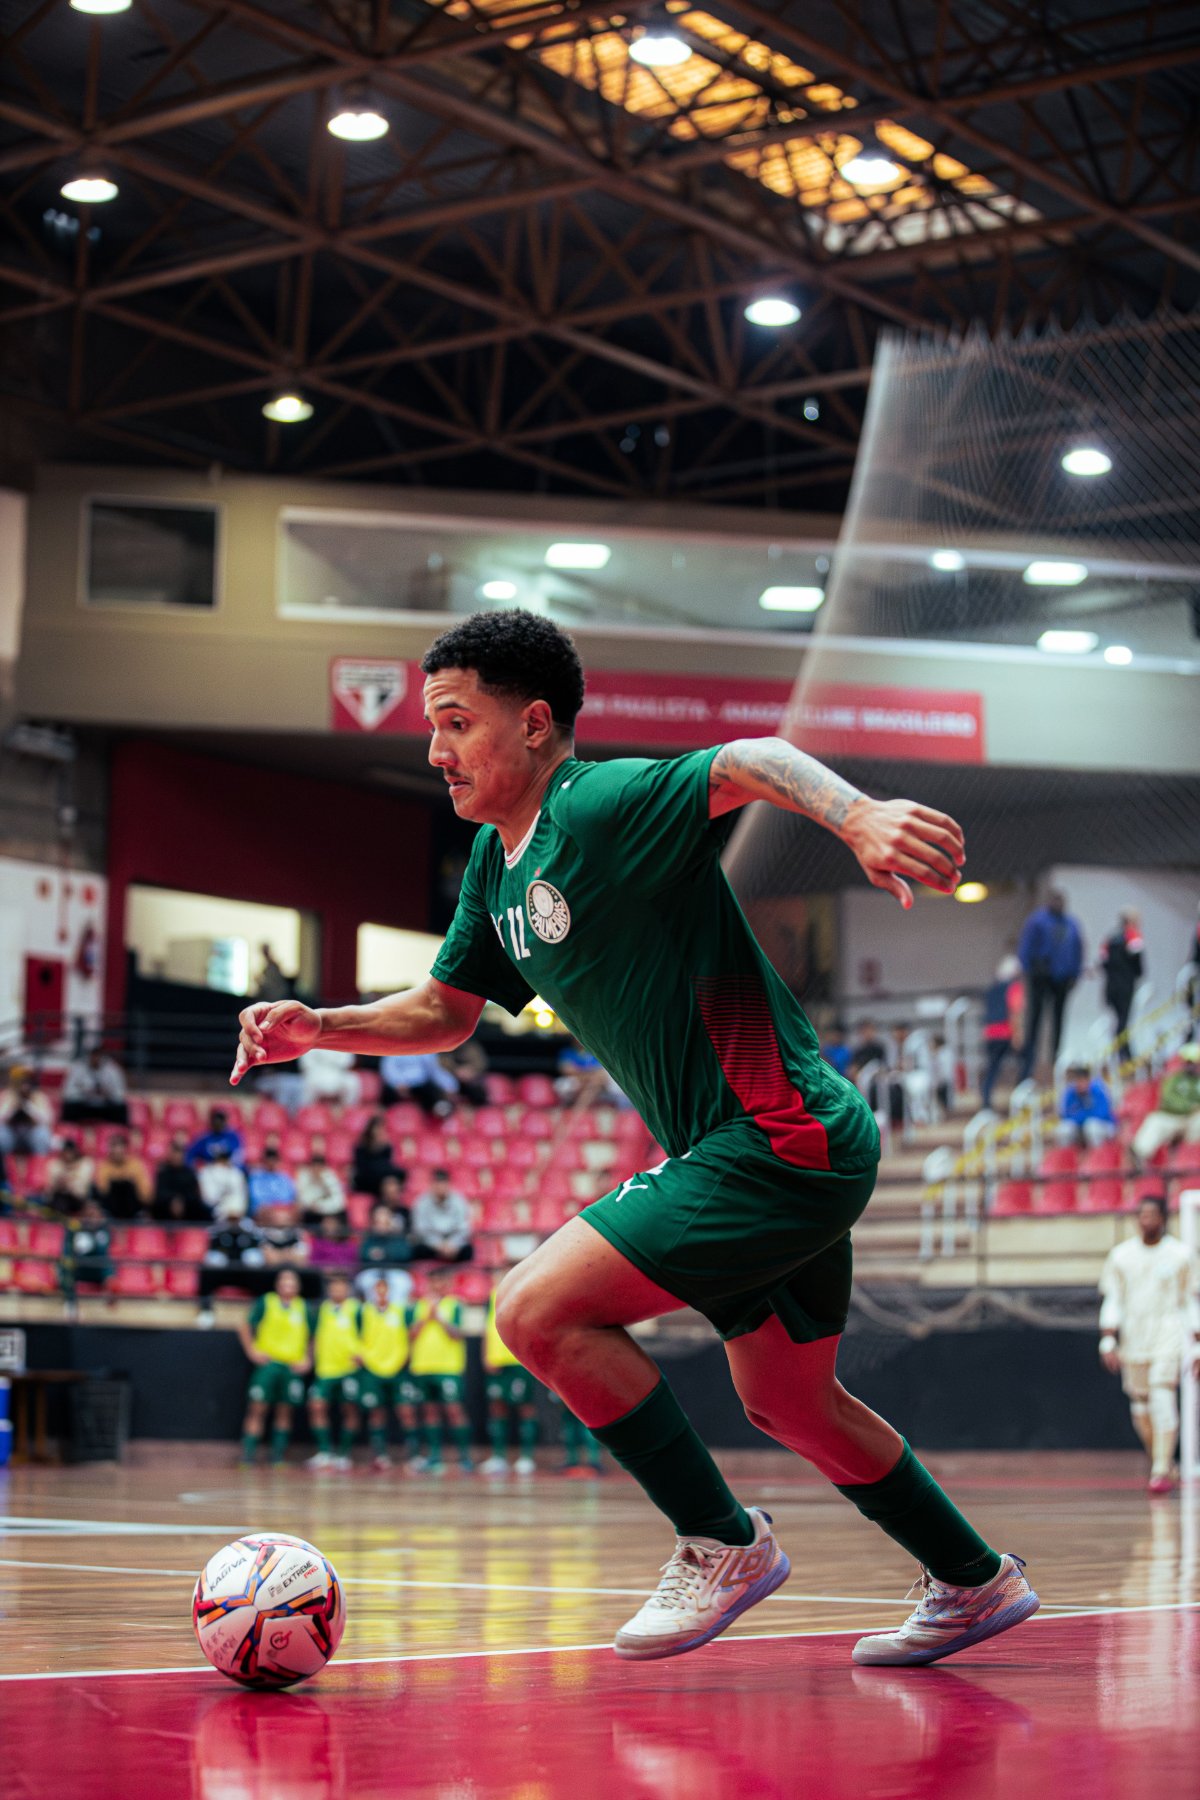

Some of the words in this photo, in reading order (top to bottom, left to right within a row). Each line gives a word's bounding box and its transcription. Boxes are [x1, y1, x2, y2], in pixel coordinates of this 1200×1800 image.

[507, 905, 531, 960] 12
[531, 901, 568, 939] PALMEIRAS
[209, 1557, 247, 1592] KAGIVA
[283, 1560, 313, 1588] EXTREME
